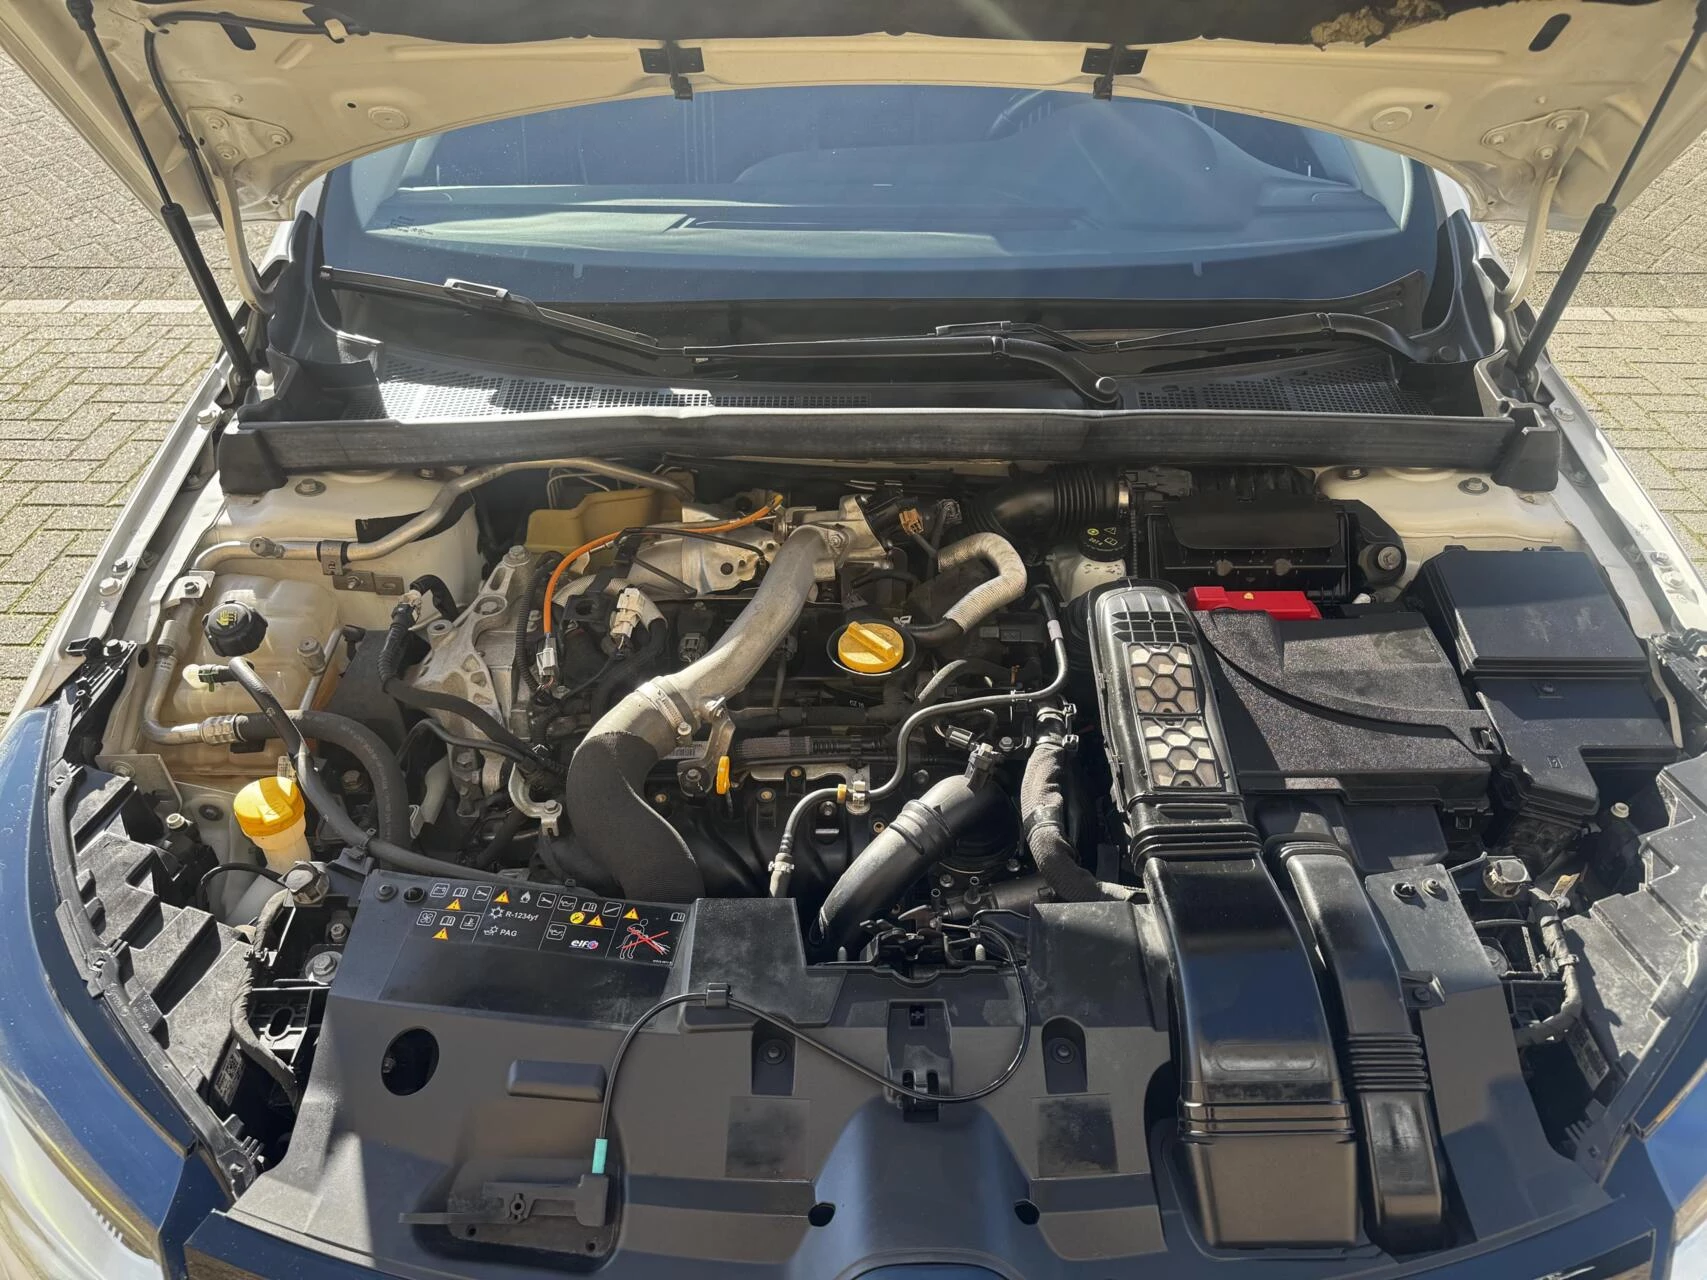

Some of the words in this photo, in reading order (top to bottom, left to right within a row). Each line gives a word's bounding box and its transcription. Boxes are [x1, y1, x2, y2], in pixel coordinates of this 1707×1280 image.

[505, 911, 539, 921] R-1234yf
[500, 929, 517, 937] PAG
[570, 939, 590, 948] elf
